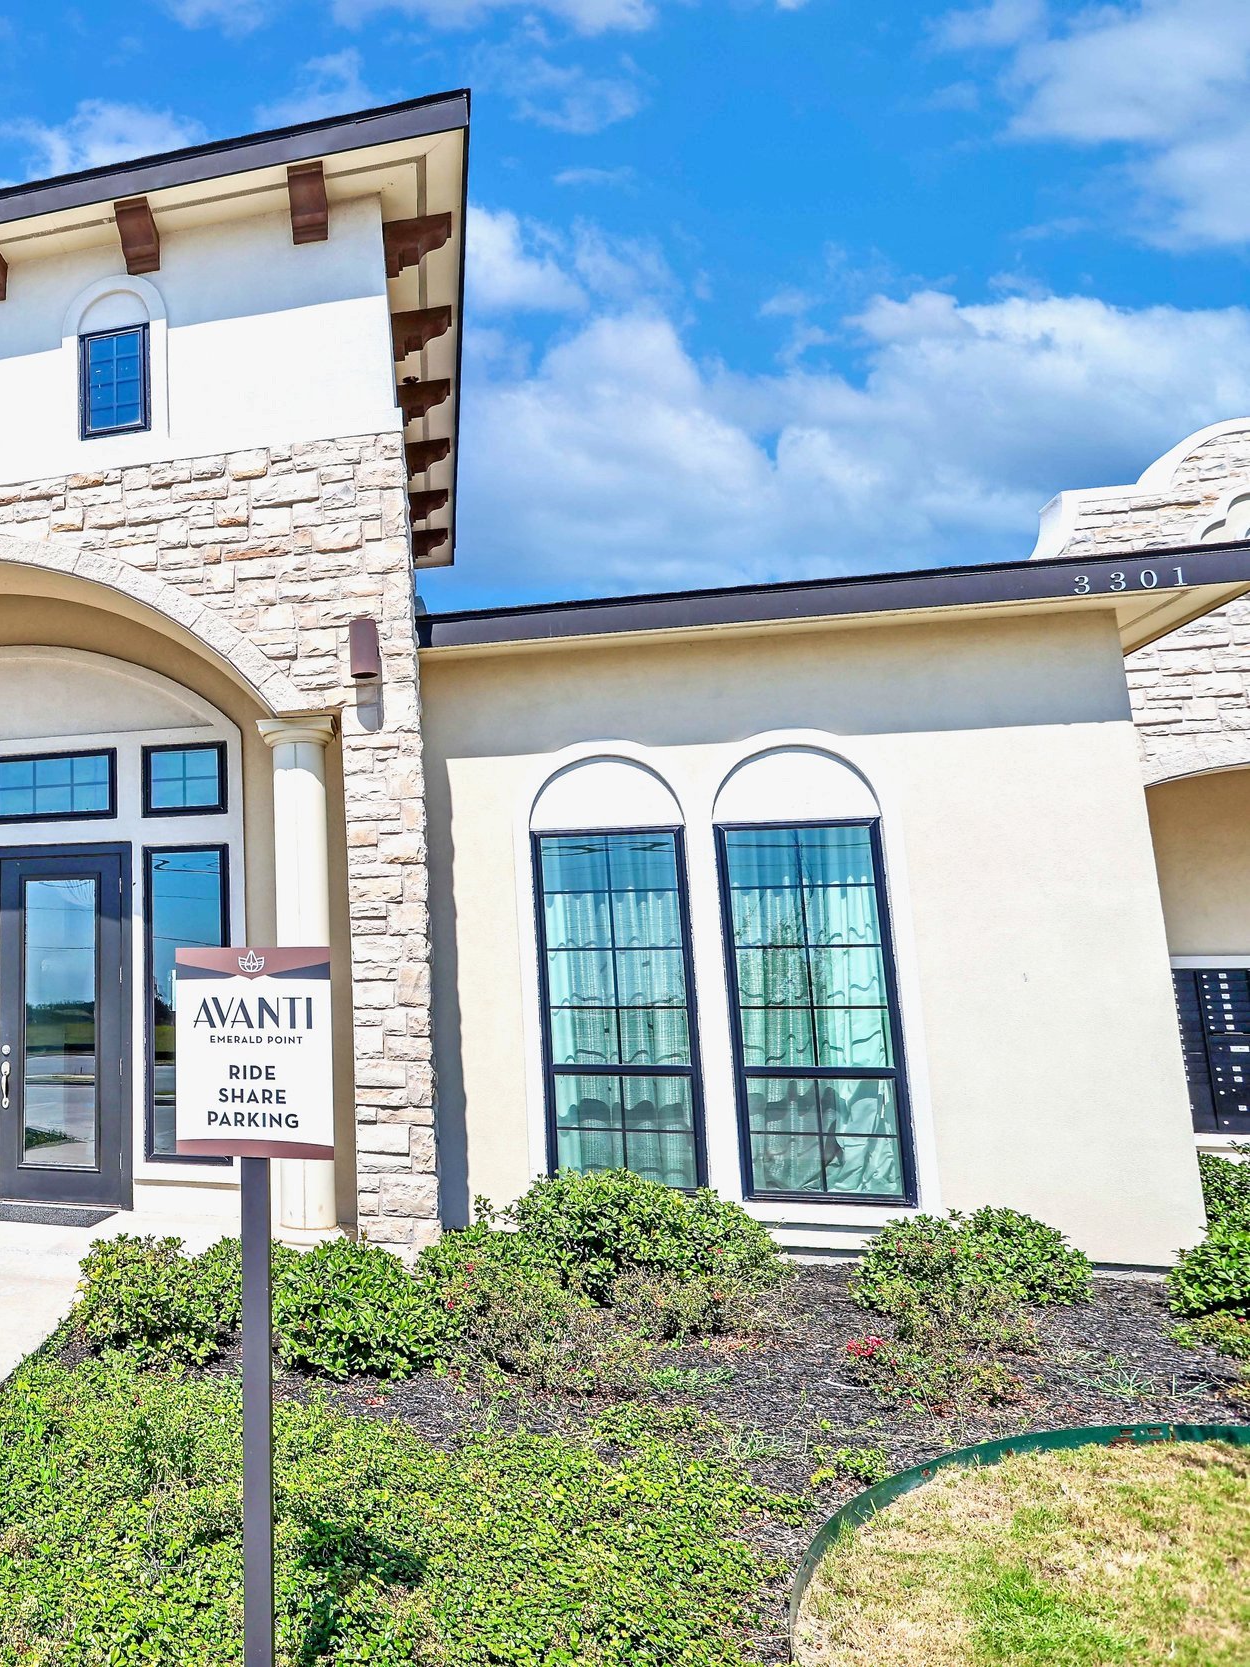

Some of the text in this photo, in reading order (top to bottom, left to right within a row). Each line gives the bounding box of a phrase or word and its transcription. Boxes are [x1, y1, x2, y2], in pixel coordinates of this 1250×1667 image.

[1073, 566, 1189, 595] 3301
[193, 997, 313, 1029] AVANTI
[210, 1035, 303, 1045] EMERALD POINT
[229, 1064, 276, 1081] RIDE
[218, 1087, 287, 1105] SHARE
[207, 1111, 299, 1129] PARKING
